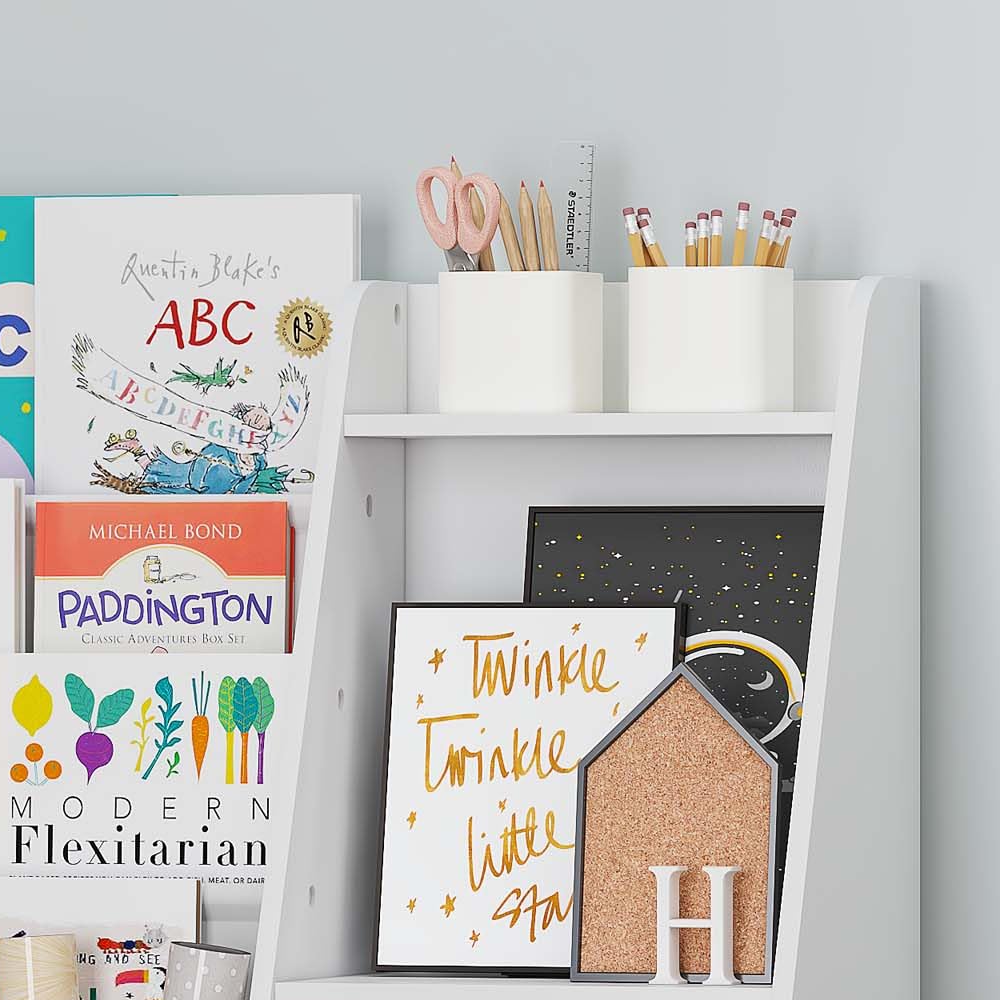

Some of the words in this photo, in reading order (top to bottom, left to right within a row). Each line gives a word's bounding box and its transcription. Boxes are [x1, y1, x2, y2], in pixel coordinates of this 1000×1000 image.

[566, 199, 575, 257] STAEDTLER
[120, 250, 199, 301] Quentin
[198, 252, 281, 288] Blake's
[145, 298, 256, 350] ABC
[88, 523, 178, 540] MICHAEL
[184, 523, 242, 540] BOND
[462, 632, 620, 699] Twinkle
[417, 713, 580, 793] Twinkle
[10, 795, 271, 821] MODERN
[10, 823, 268, 867] Flexitarian
[648, 866, 742, 985] H
[139, 954, 161, 965] SEE
